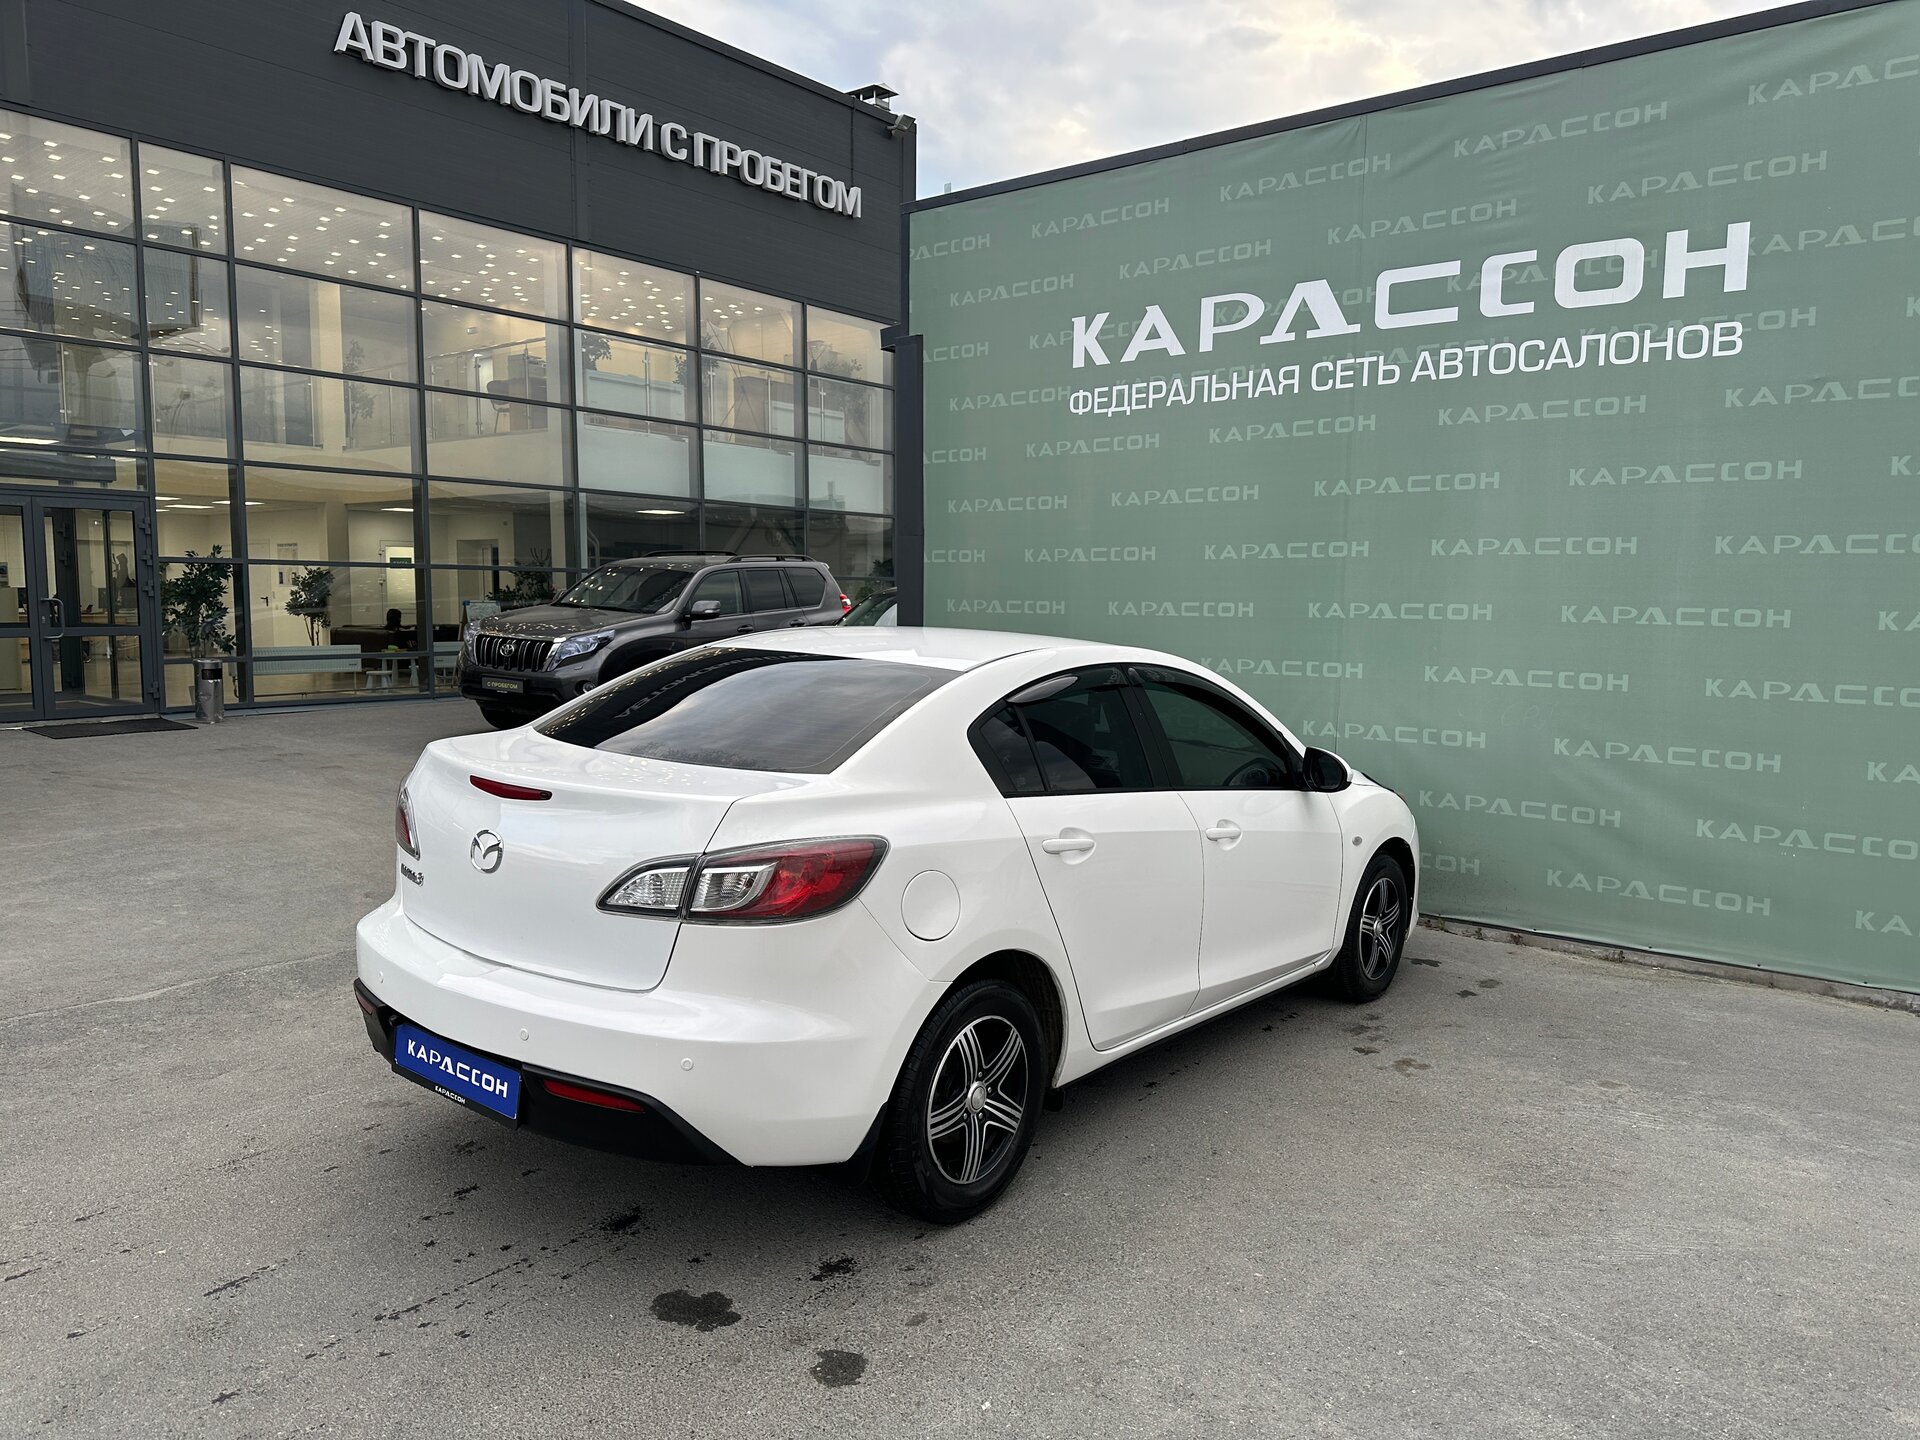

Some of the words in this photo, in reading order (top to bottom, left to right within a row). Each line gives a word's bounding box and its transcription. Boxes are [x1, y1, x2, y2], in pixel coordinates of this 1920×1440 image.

[334, 11, 654, 152] АВТОМОБИЛИ
[661, 122, 688, 161] С
[694, 131, 862, 219] ПРОБЕГОМ
[1069, 364, 1300, 418] ФЕДЕРАЛЬНАЯ
[1310, 355, 1400, 393] СЕТЬ
[1410, 321, 1744, 383] АВТОСАЛОНОВ
